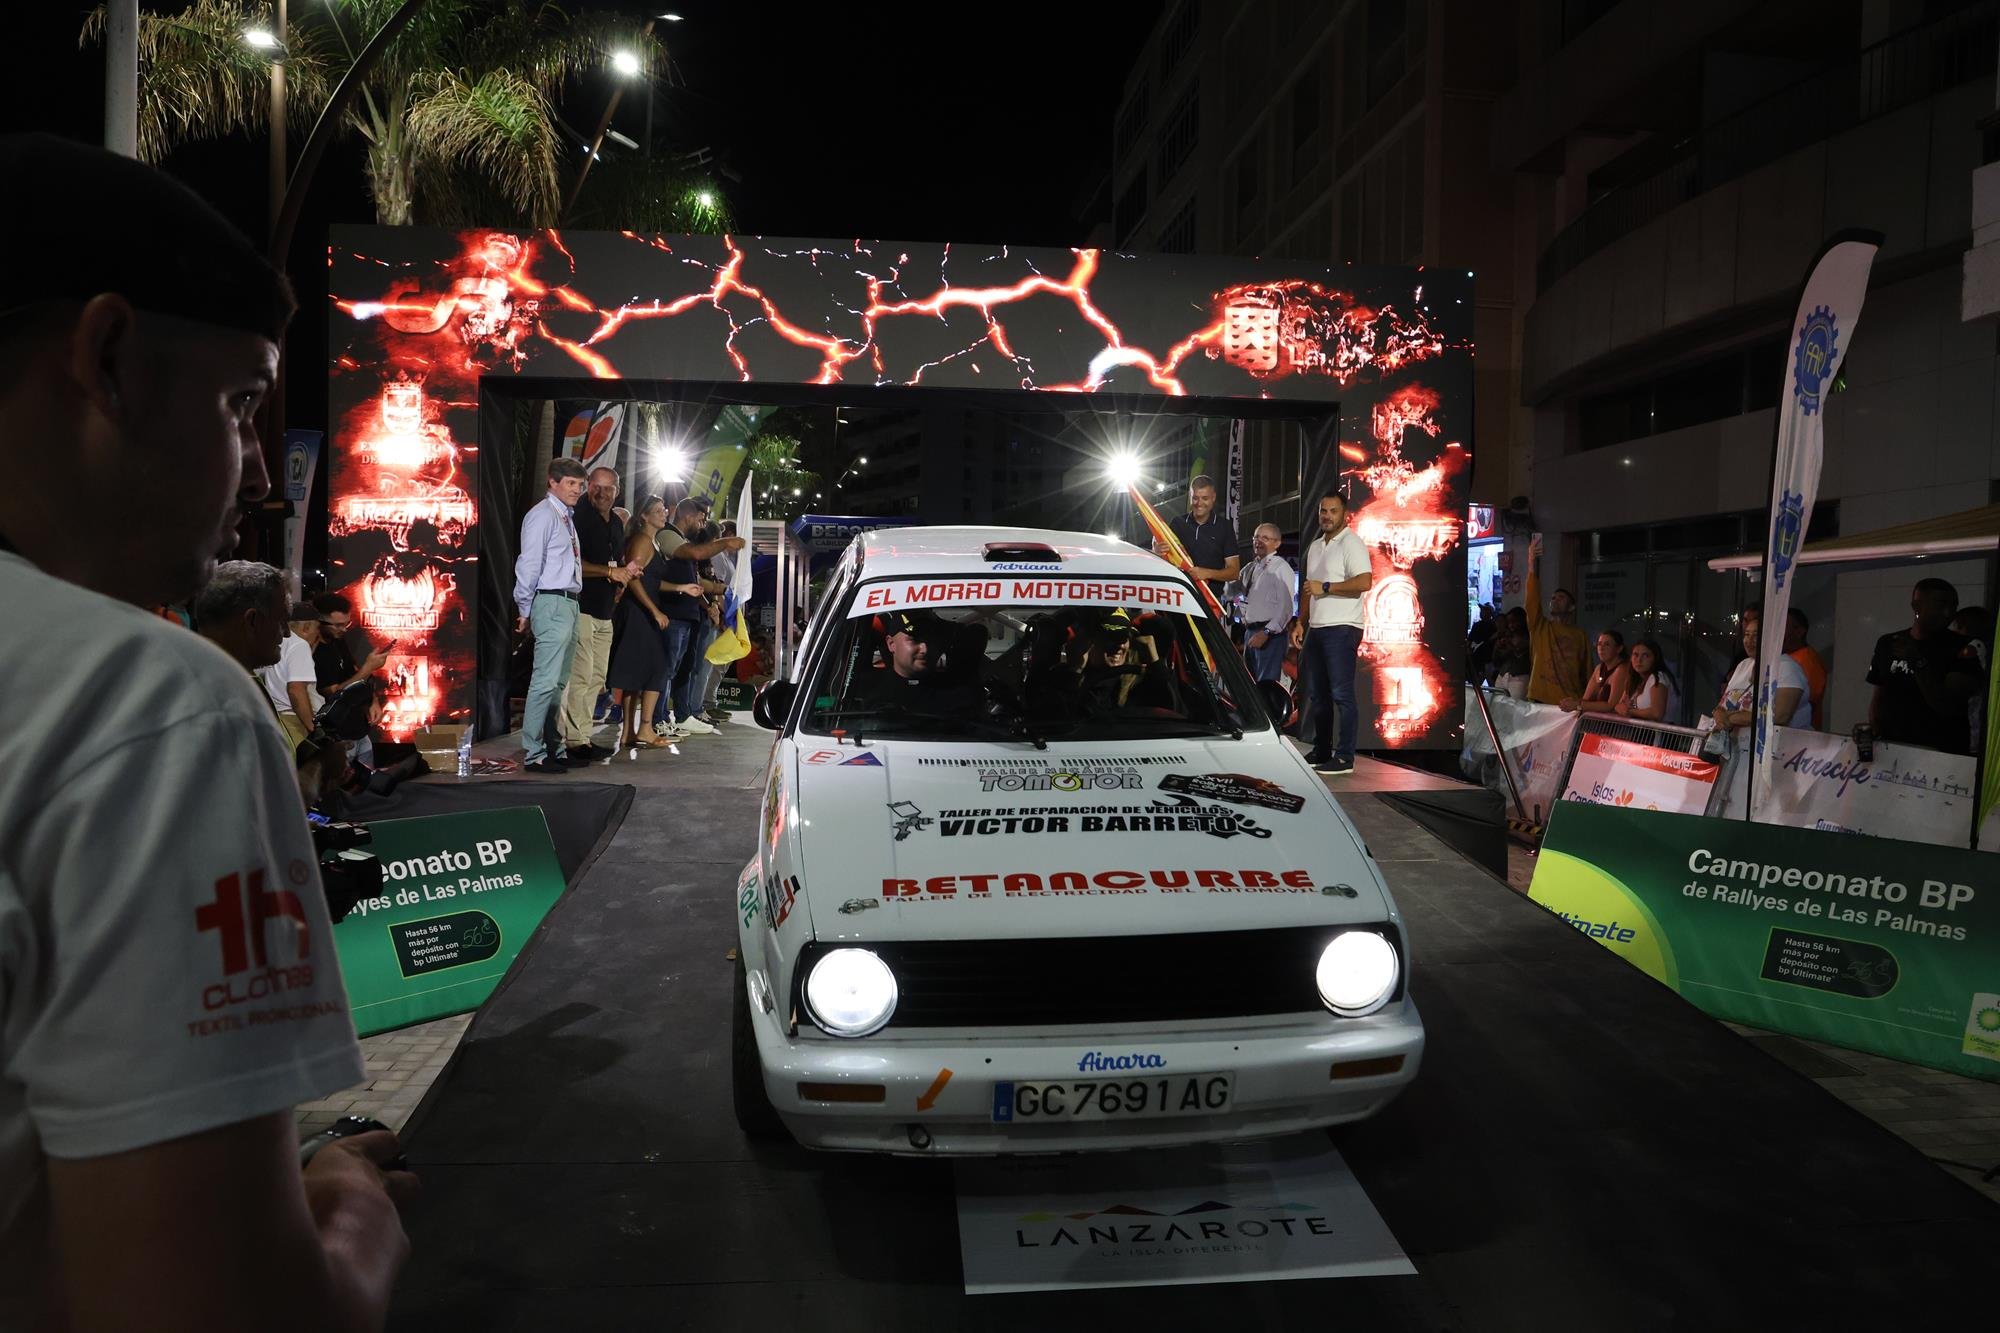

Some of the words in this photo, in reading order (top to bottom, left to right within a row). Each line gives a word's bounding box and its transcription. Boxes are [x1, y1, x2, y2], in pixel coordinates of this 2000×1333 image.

[992, 562, 1062, 571] Adriana
[866, 588, 896, 608] EL
[906, 582, 1000, 603] MORRO
[1013, 581, 1184, 607] MOTORSPORT
[1784, 747, 1871, 798] Arrecife
[979, 773, 1144, 792] TOMOTOR
[1592, 780, 1614, 802] Islas
[939, 807, 991, 818] TALLER
[995, 806, 1016, 817] DE
[1114, 805, 1141, 815] DE
[939, 817, 1070, 837] VICTOR
[1081, 815, 1237, 833] BARRETO
[476, 839, 513, 866] BP
[395, 888, 420, 906] de
[422, 882, 457, 901] Las
[458, 872, 524, 895] Palmas
[882, 869, 1314, 898] BETANCURBE
[1687, 848, 1908, 903] Campeonato
[1919, 880, 1975, 911] BP
[884, 894, 954, 902] TALLER
[1005, 888, 1148, 897] ELECTRICIDAD
[1161, 887, 1196, 895] DEL
[1682, 880, 1708, 899] de
[1711, 884, 1788, 911] Rallyes
[1793, 897, 1822, 917] de
[1828, 901, 1868, 925] Las
[1874, 909, 1967, 942] Palmas
[405, 926, 428, 939] Hasta
[428, 925, 439, 934] 56
[438, 923, 452, 933] km
[408, 936, 425, 948] más
[426, 935, 440, 946] por
[411, 943, 444, 958] depósito
[445, 940, 459, 950] con
[1785, 937, 1811, 950] Hasta
[1812, 942, 1824, 952] 56
[1825, 944, 1841, 955] km
[413, 957, 424, 967] bp
[1783, 947, 1801, 958] más
[1803, 952, 1820, 962] por
[1778, 966, 1790, 976] bp
[1780, 956, 1820, 973] depósito
[1821, 965, 1839, 975] con
[1077, 1052, 1167, 1072] Ainara
[1016, 1217, 1334, 1248] LANZAROTE
[1101, 1250, 1121, 1258] LA
[1129, 1247, 1165, 1257] ISLA
